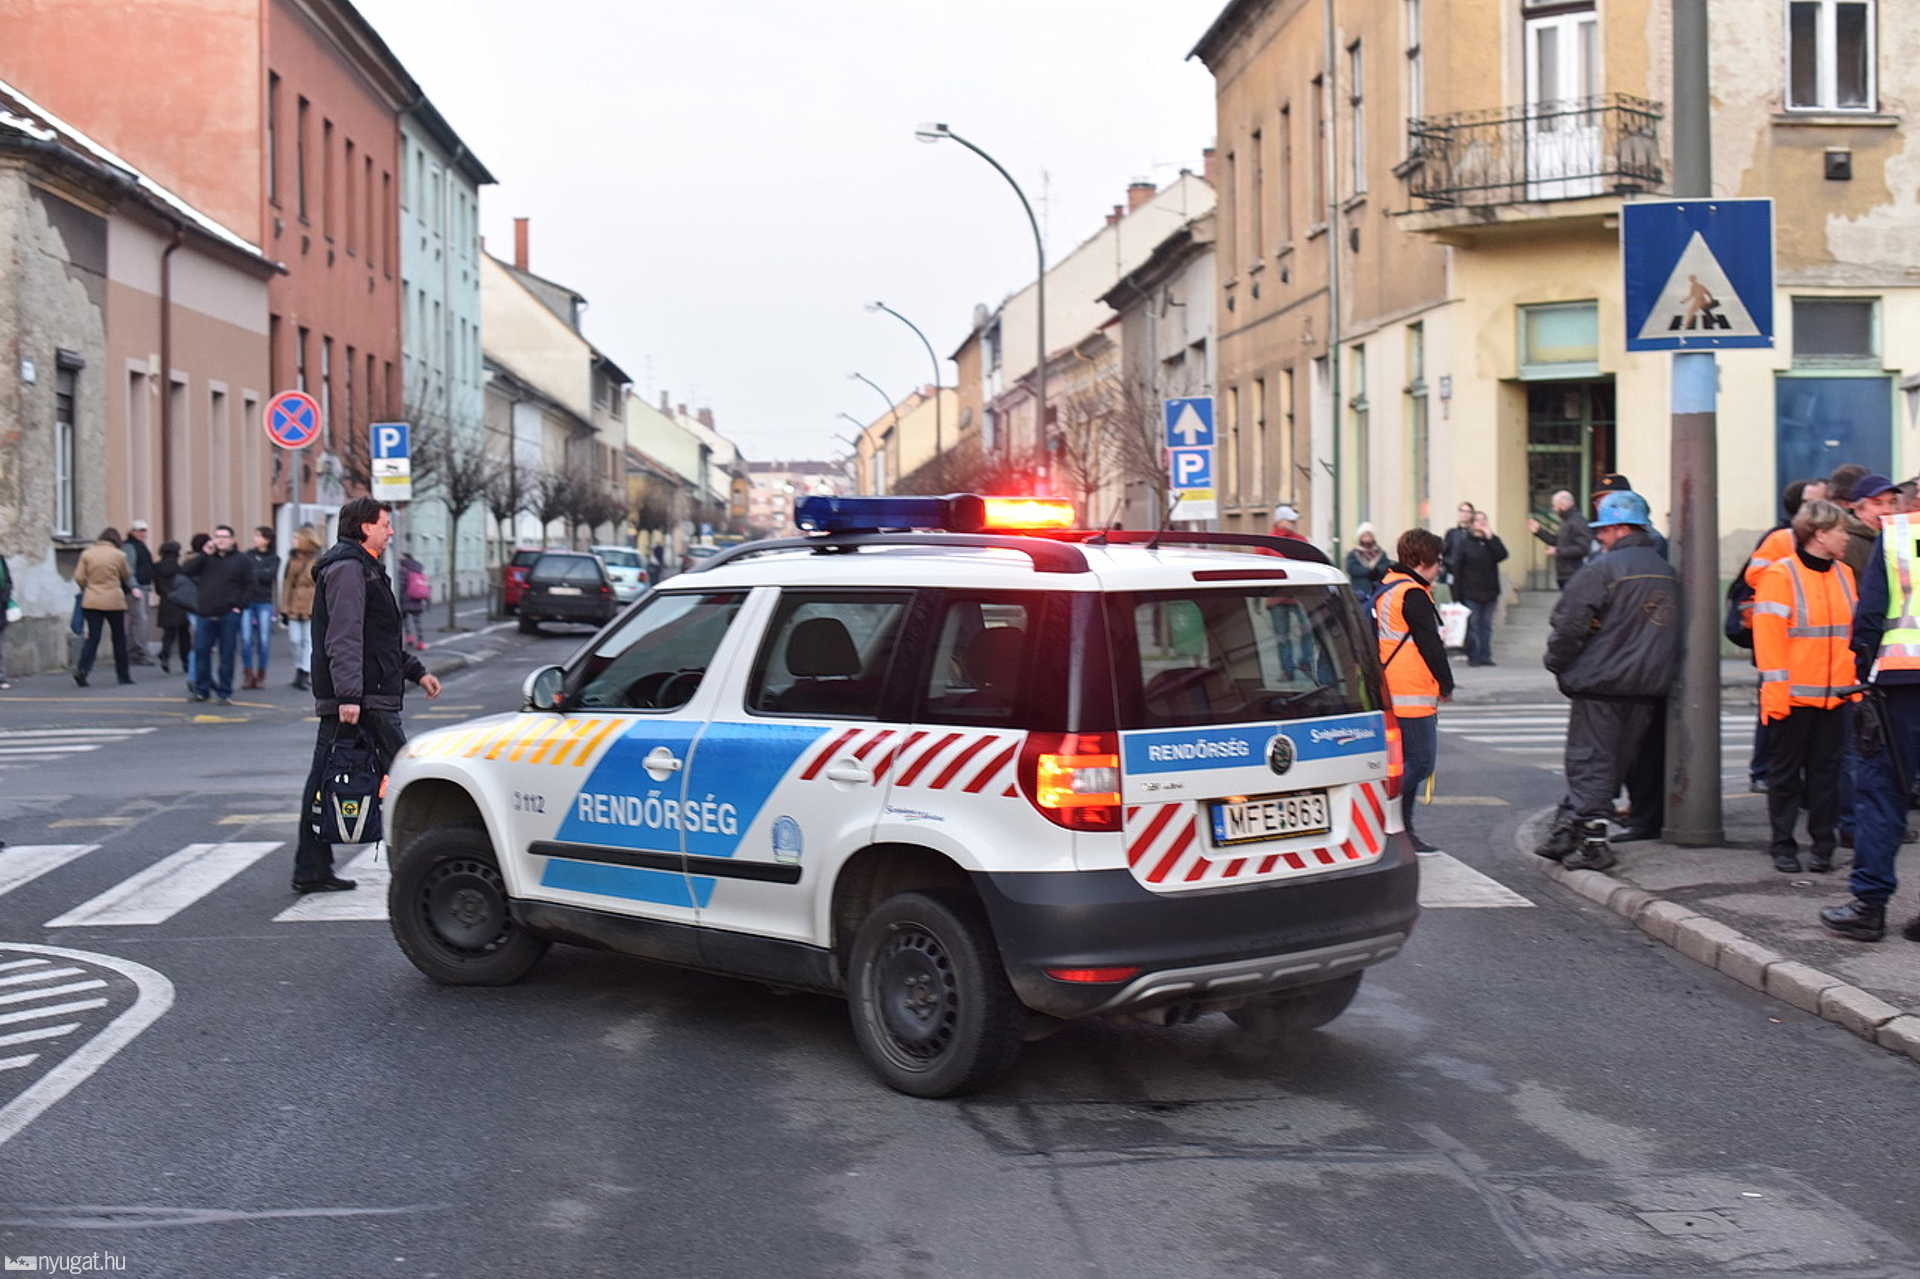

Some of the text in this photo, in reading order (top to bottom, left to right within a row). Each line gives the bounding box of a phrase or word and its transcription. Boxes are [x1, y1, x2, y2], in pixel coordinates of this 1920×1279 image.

[379, 427, 401, 458] P
[1177, 453, 1205, 485] P
[1148, 737, 1250, 761] RENDŐRSÉG
[577, 790, 739, 836] RENDŐRSÉG
